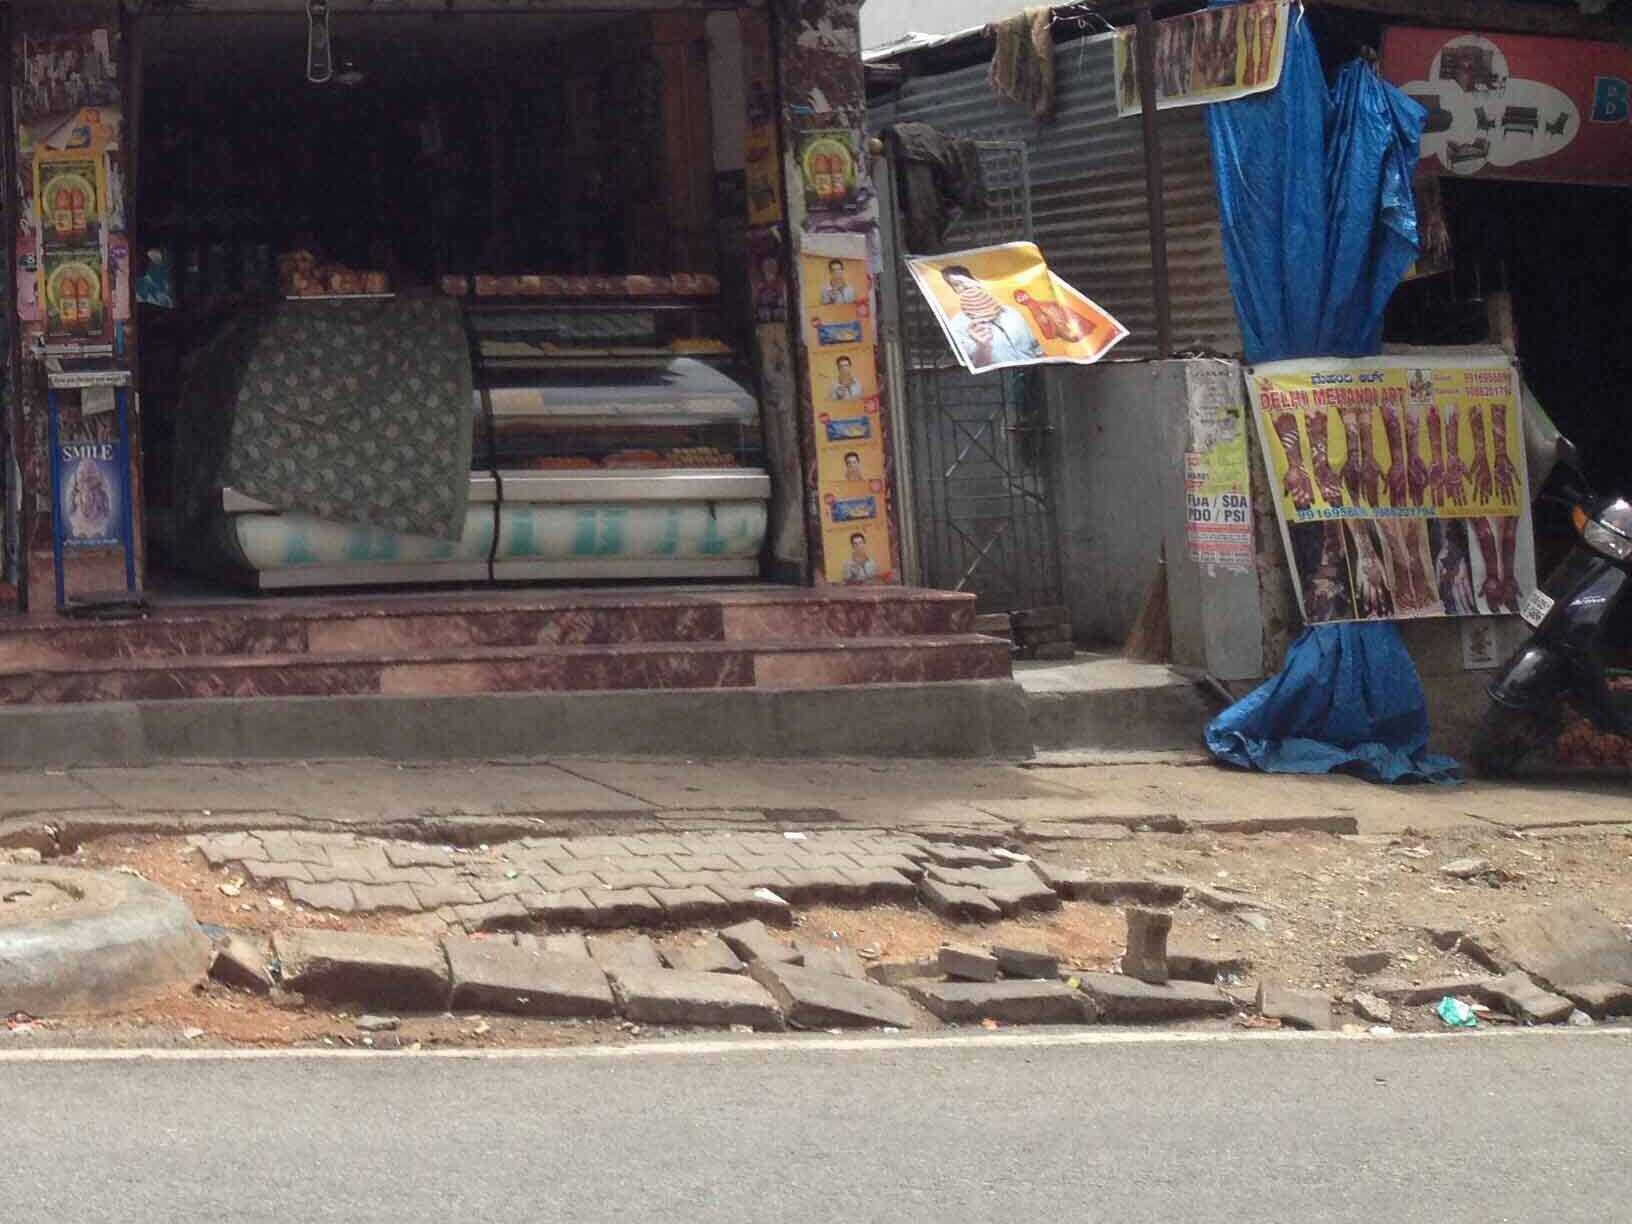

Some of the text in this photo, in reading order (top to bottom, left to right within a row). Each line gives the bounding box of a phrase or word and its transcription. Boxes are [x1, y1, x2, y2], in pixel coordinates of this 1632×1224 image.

[62, 444, 113, 462] SMILE
[1222, 494, 1248, 508] SDA
[1224, 510, 1245, 523] PSI
